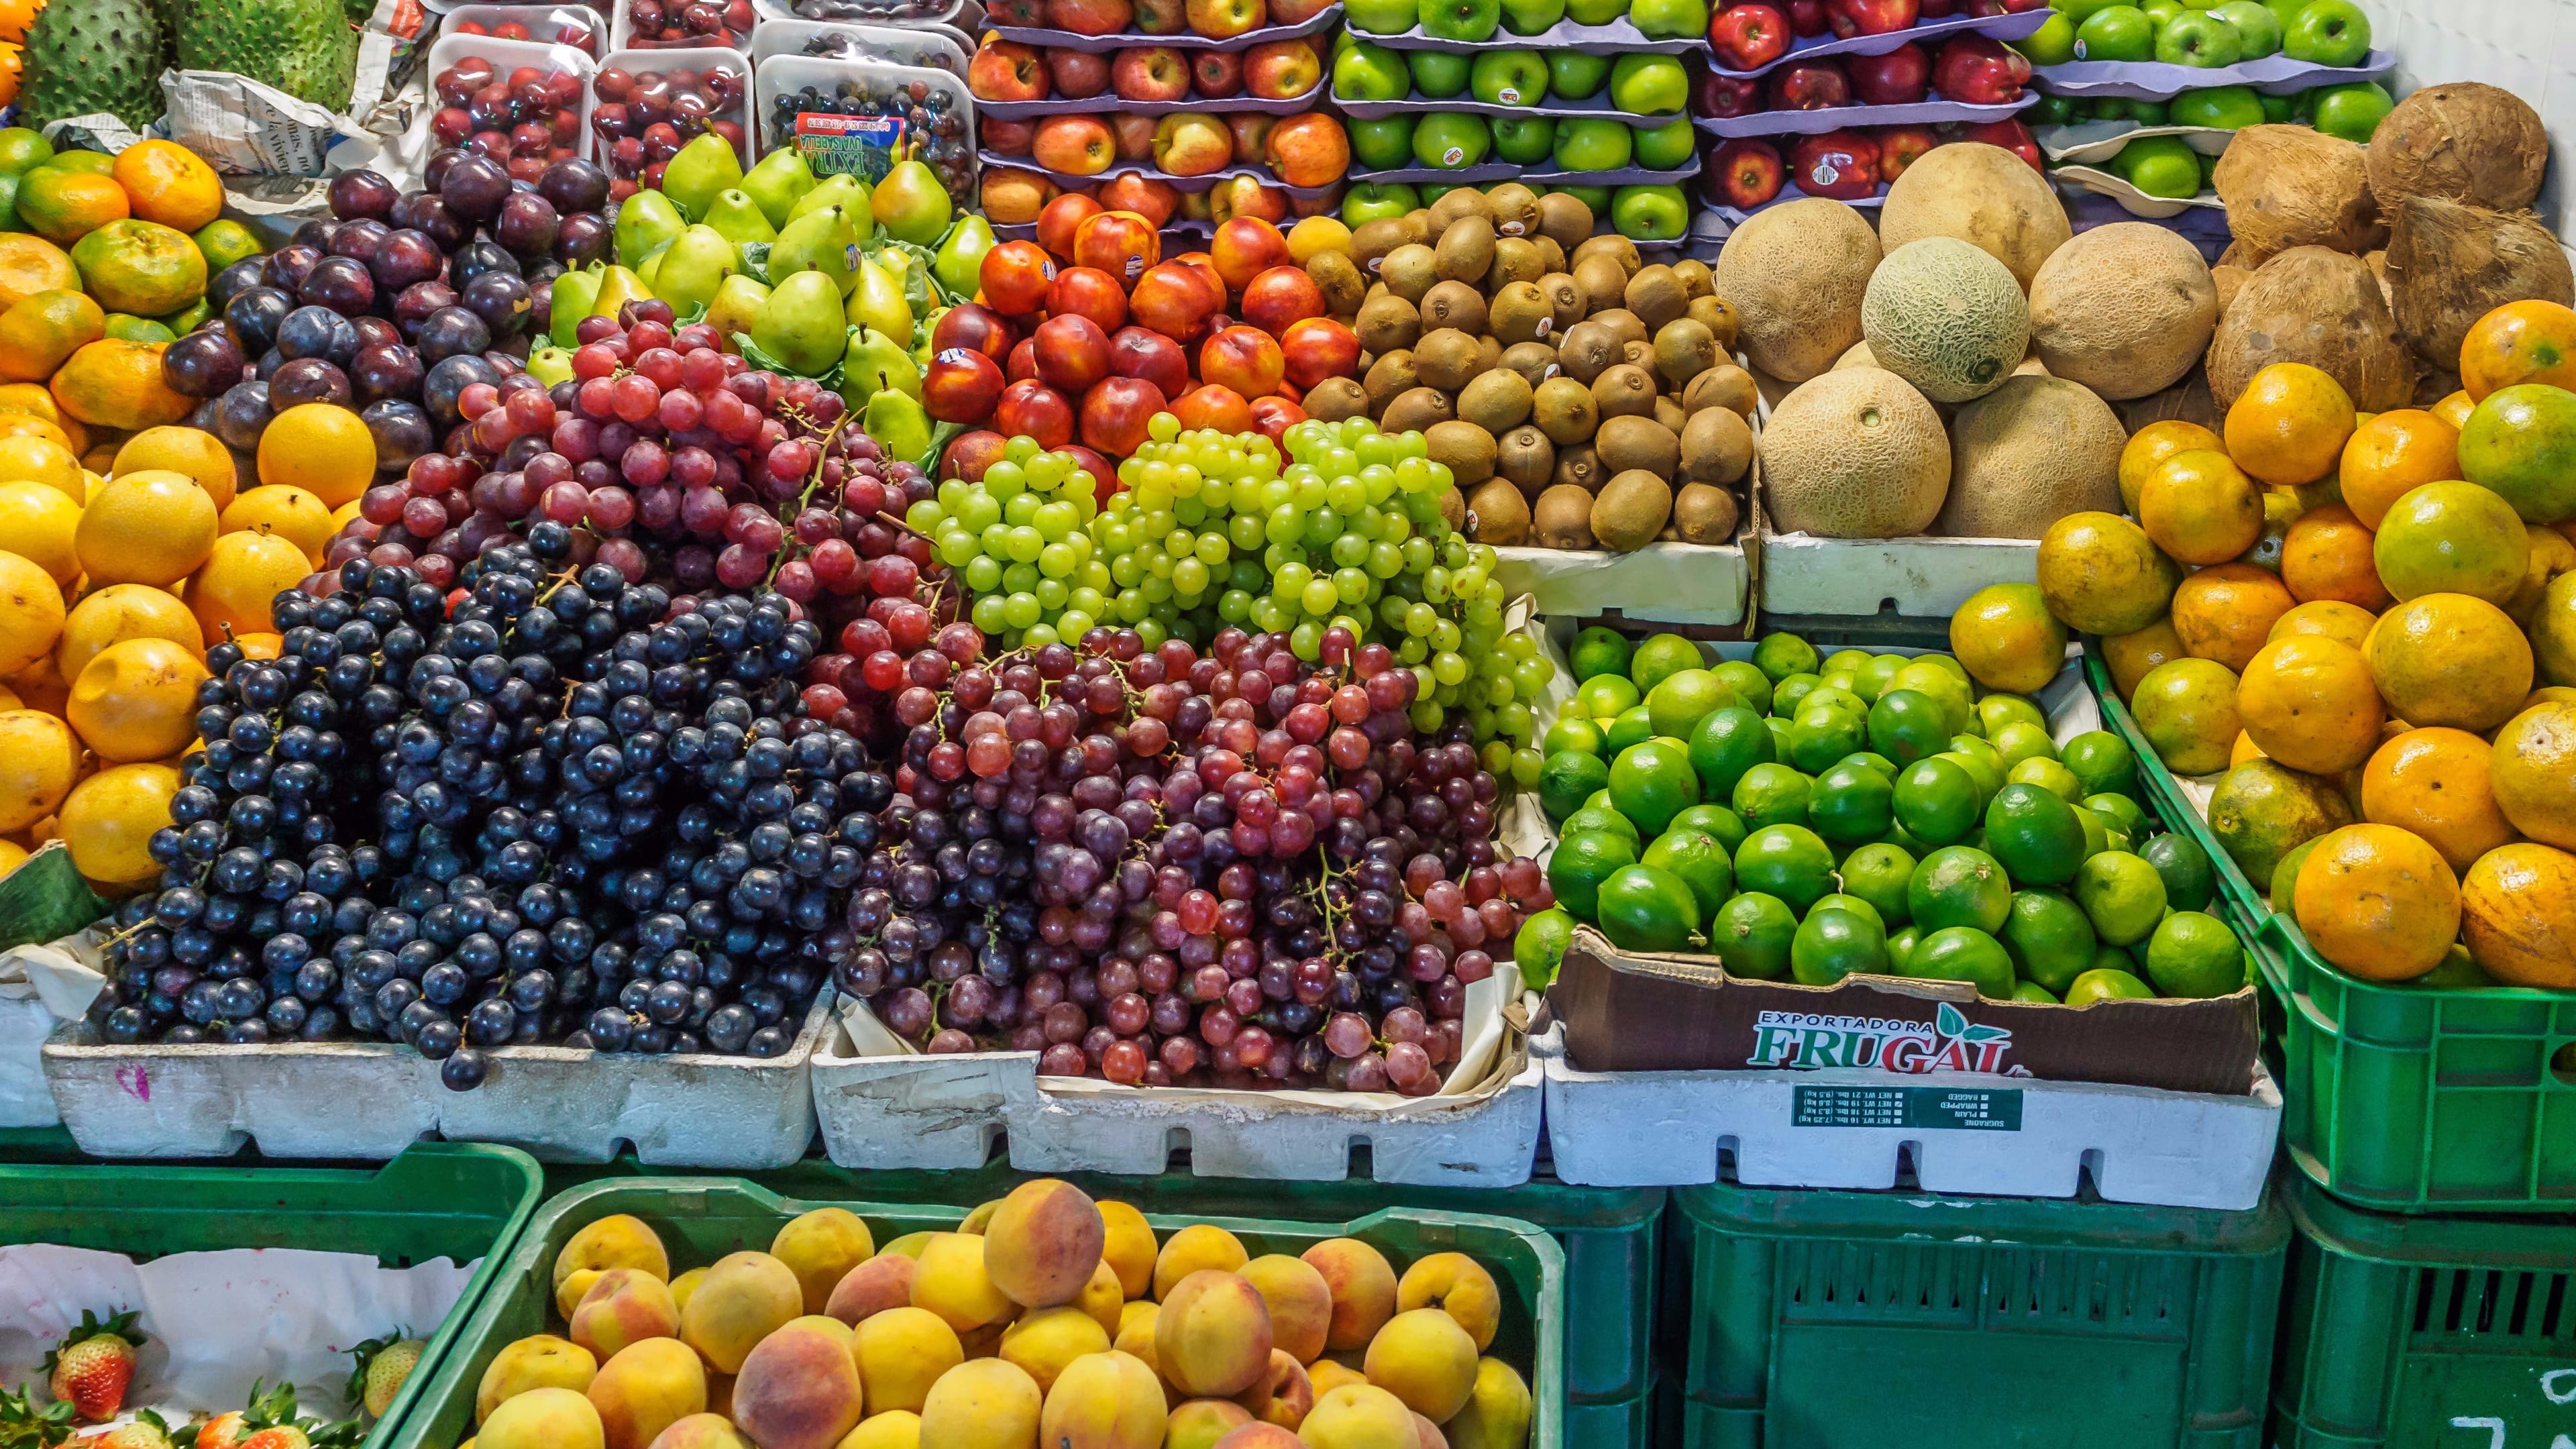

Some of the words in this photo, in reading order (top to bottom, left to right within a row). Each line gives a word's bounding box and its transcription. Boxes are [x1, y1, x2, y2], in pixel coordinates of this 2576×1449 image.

[799, 134, 843, 150] ISABELLA
[843, 136, 863, 151] UVA
[297, 156, 311, 172] no
[803, 150, 866, 175] EXTRA
[1762, 1012, 1933, 1034] EXPORTADORA
[1749, 1025, 2015, 1075] FRUGAL
[1964, 1119, 2004, 1127] SUGRAONE
